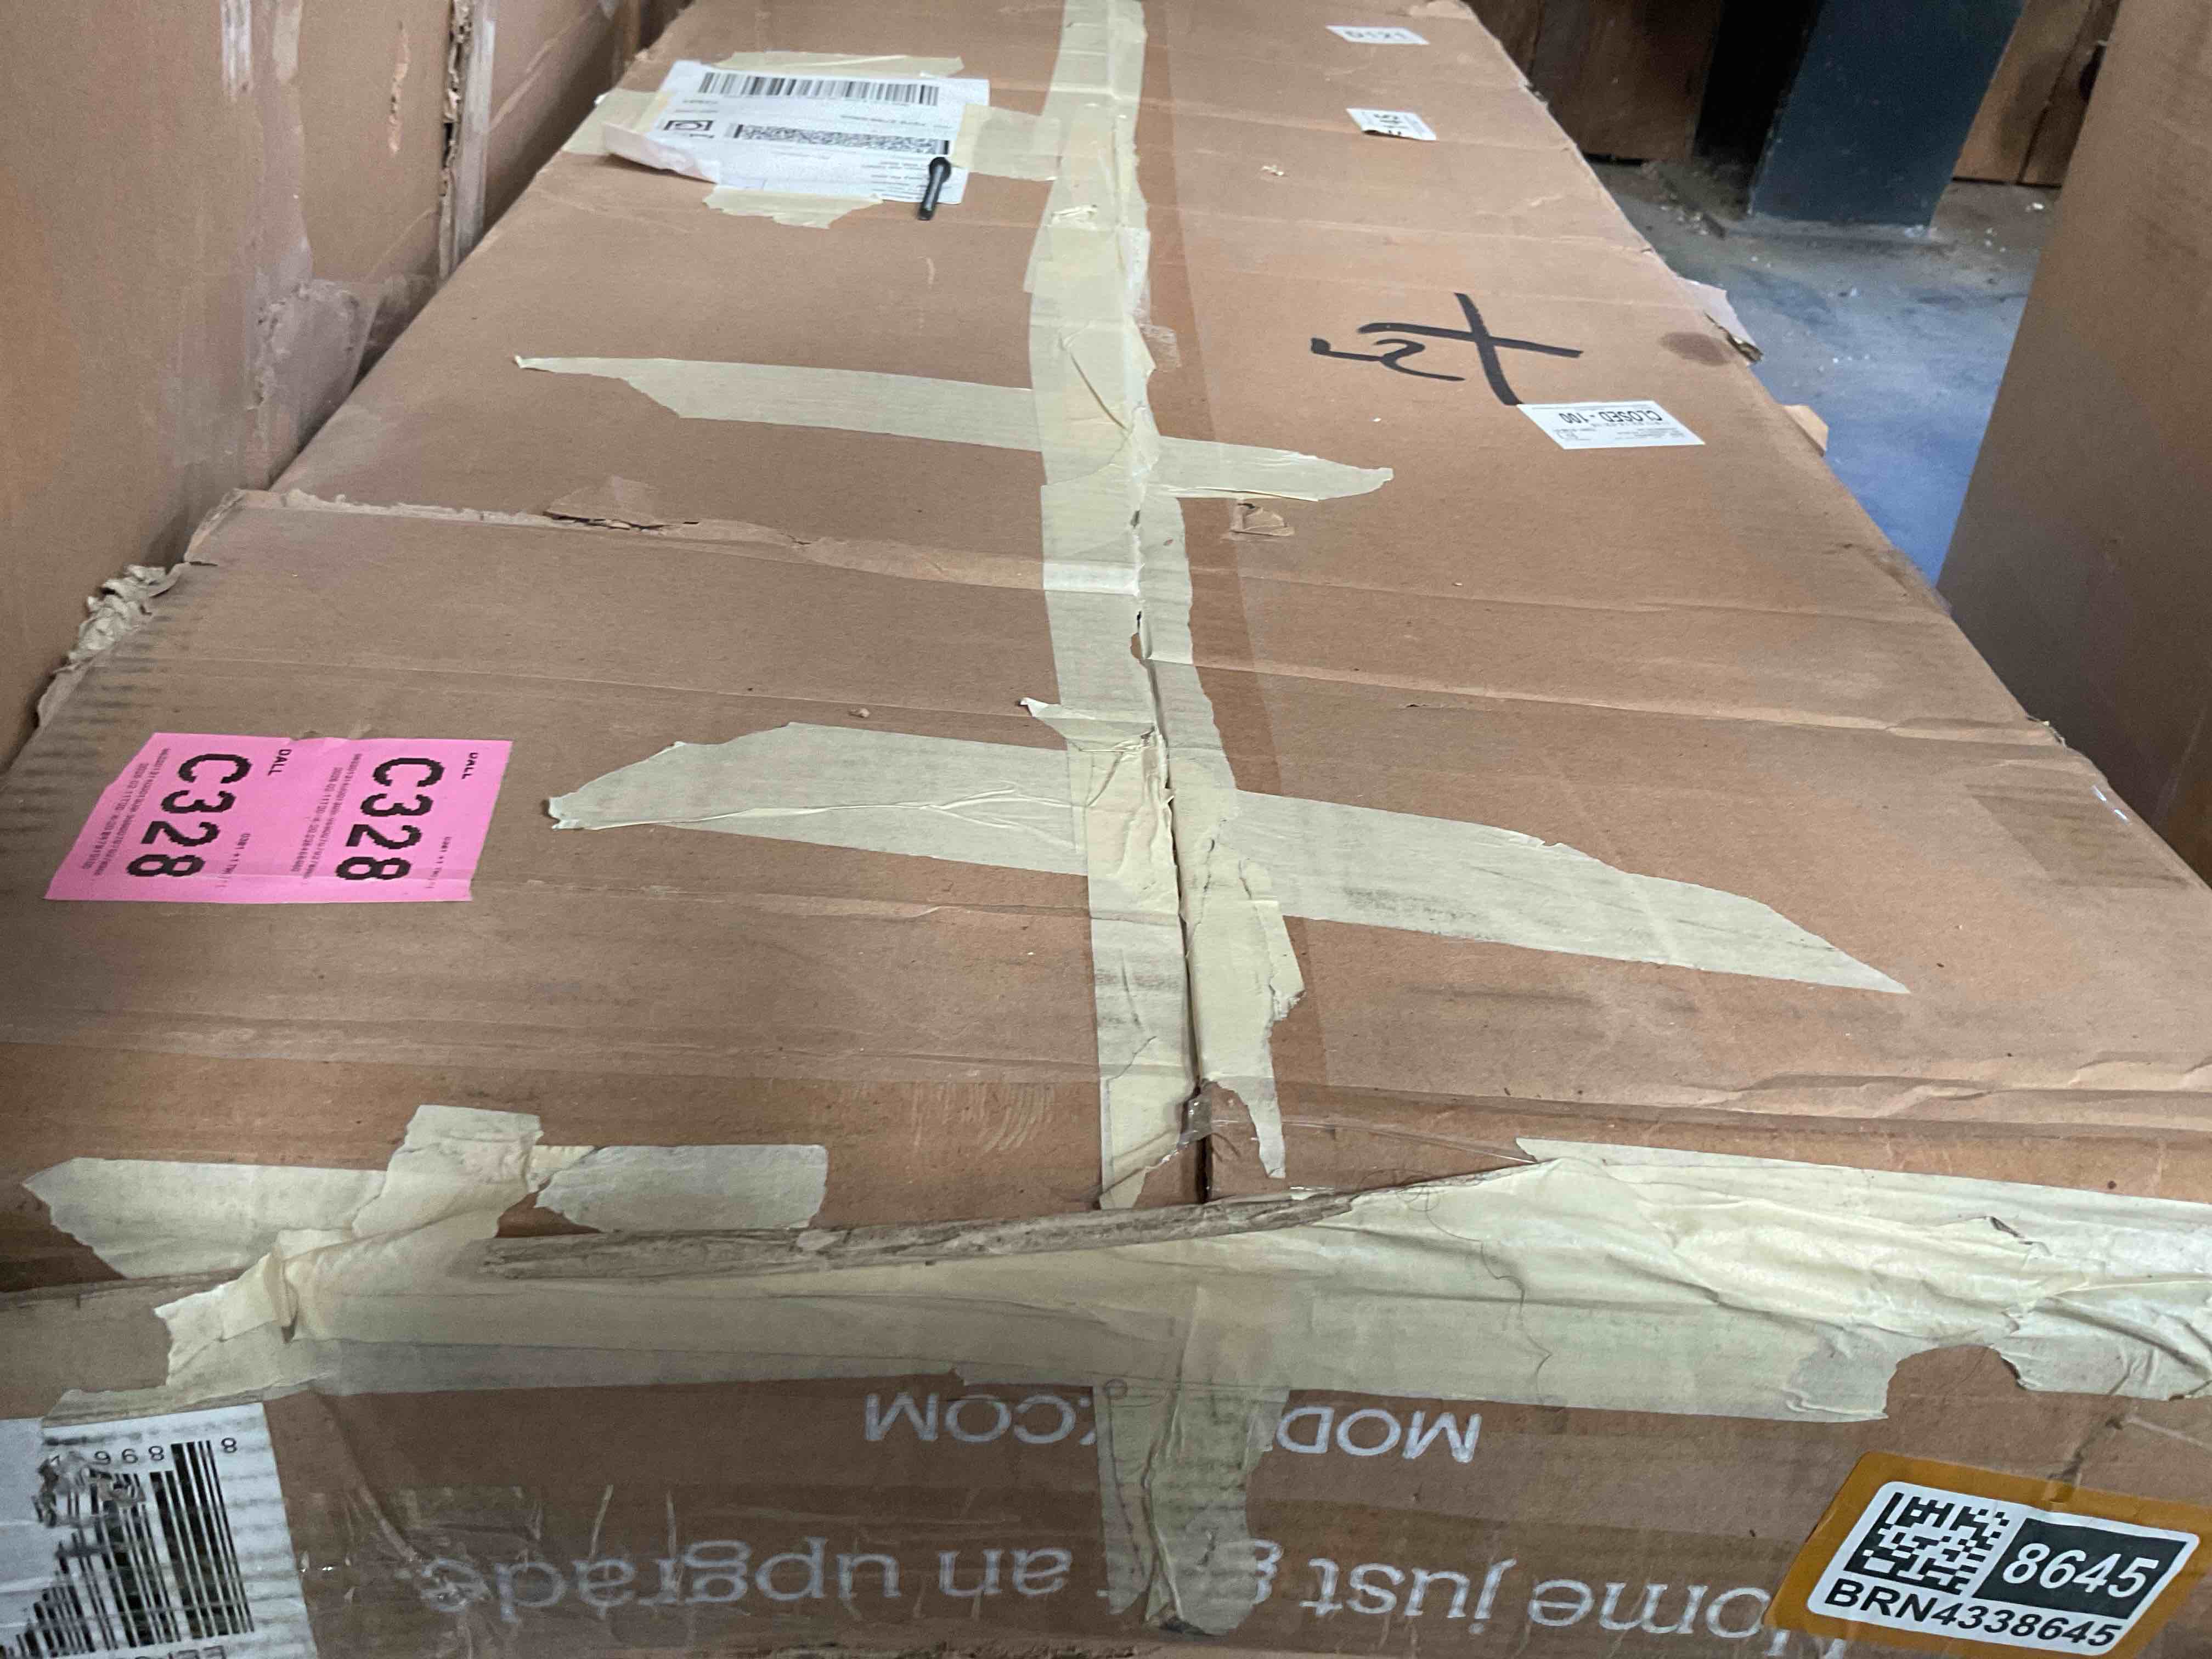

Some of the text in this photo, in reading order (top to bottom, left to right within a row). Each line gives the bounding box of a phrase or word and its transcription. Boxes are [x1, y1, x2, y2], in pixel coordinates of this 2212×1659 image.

[1558, 412, 1589, 424] 100
[1598, 410, 1663, 422] CLOSED
[268, 749, 292, 776] DALL
[126, 754, 252, 877] C328
[335, 757, 445, 880] C328
[221, 1437, 238, 1454] 8
[936, 1546, 1073, 1598] an
[1300, 1558, 1516, 1634] just
[2002, 1542, 2159, 1599] 8645
[1824, 1578, 2125, 1646] BRN4338645
